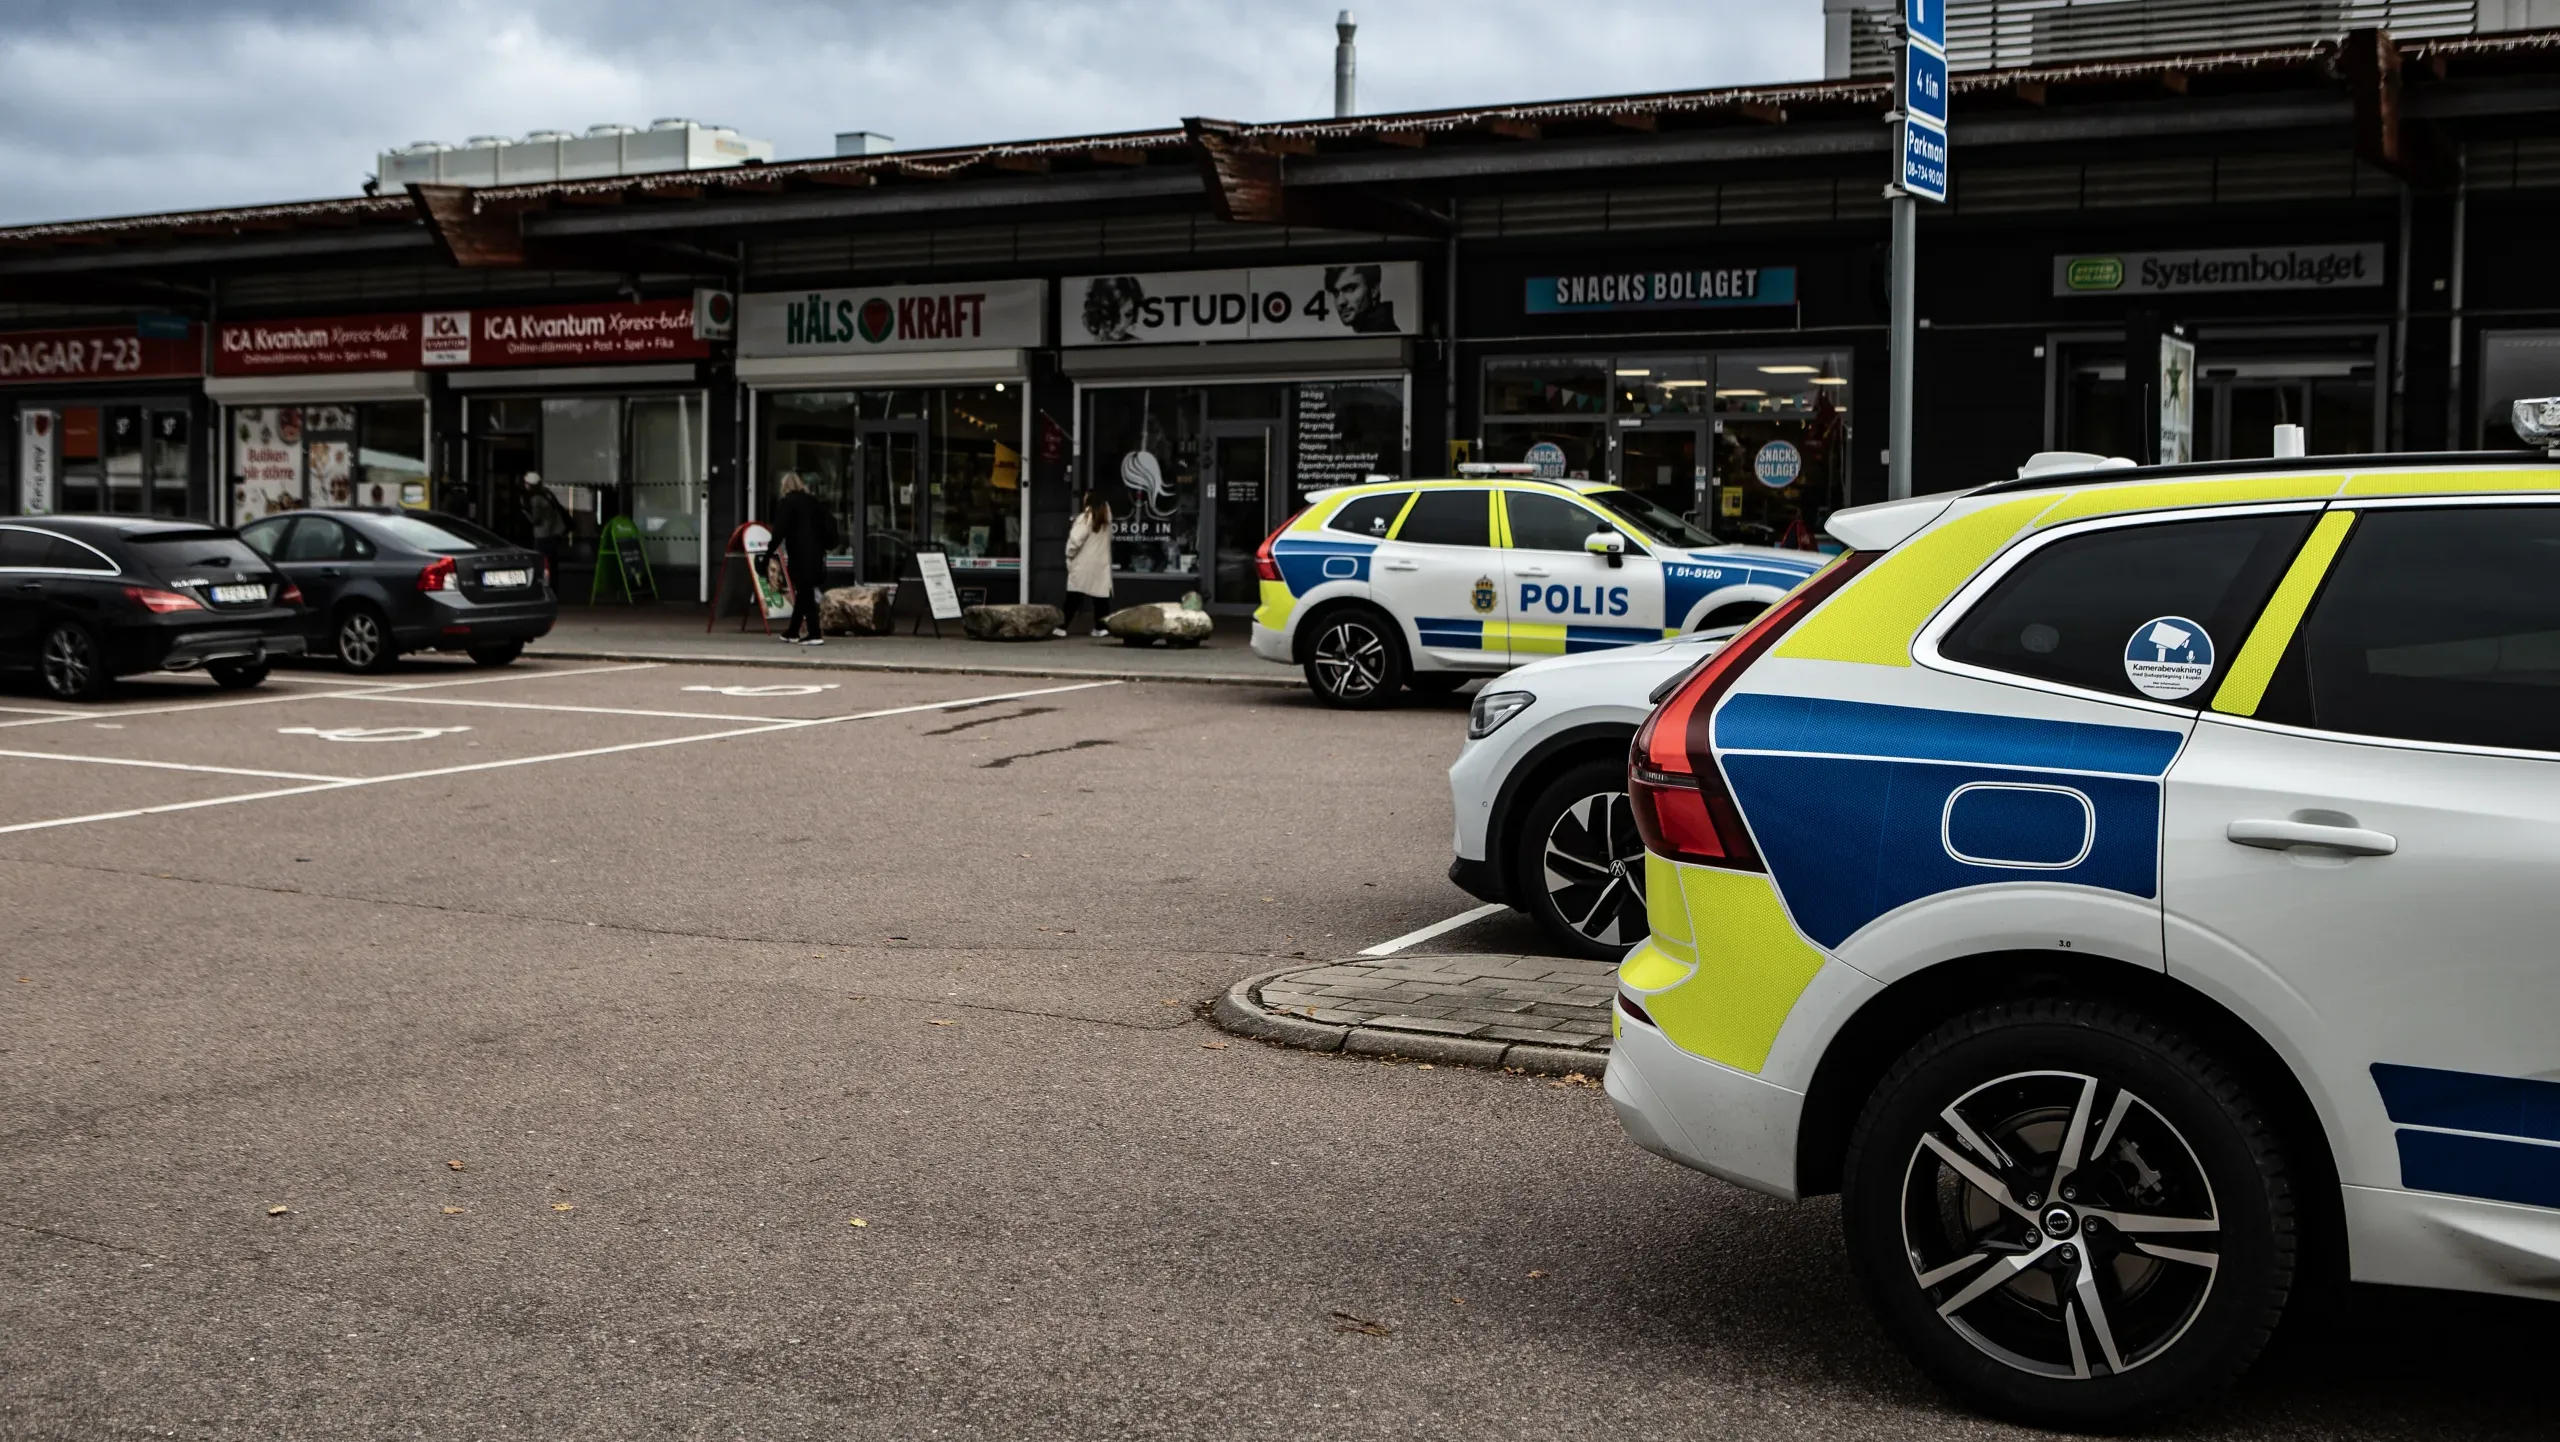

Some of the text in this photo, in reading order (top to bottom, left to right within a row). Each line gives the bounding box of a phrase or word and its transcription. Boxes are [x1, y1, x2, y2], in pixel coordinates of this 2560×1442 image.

[1916, 68, 1939, 100] 4 tim
[1908, 129, 1944, 165] Parkman
[1907, 160, 1928, 181] 08-734
[2141, 250, 2366, 290] Systembolaget
[1556, 268, 1758, 305] SNACKS BOLAGET
[787, 293, 986, 345] HÄLS KRAFT
[1142, 290, 1330, 328] STUDIO 4
[432, 315, 459, 336] ICA
[484, 316, 517, 341] ICA
[521, 313, 605, 338] Kvantum
[222, 328, 252, 352] ICA
[254, 326, 329, 351] Kvantum
[593, 339, 613, 351] Post
[624, 338, 645, 350] Spel
[655, 336, 675, 349] Fika
[0, 336, 142, 376] DAGAR 7-23
[1298, 432, 1343, 440] Permanent
[1527, 449, 1563, 463] SNACKS
[1758, 447, 1799, 463] SNACKS
[1757, 462, 1800, 479] BOLAGET
[1111, 522, 1171, 534] DROP IN
[1666, 567, 1723, 580] 1 51-5120
[1520, 584, 1629, 616] POLIS
[2132, 663, 2202, 675] Kamerabevakning
[2143, 672, 2182, 681] ljudupptagning
[2058, 939, 2071, 948] 3.0
